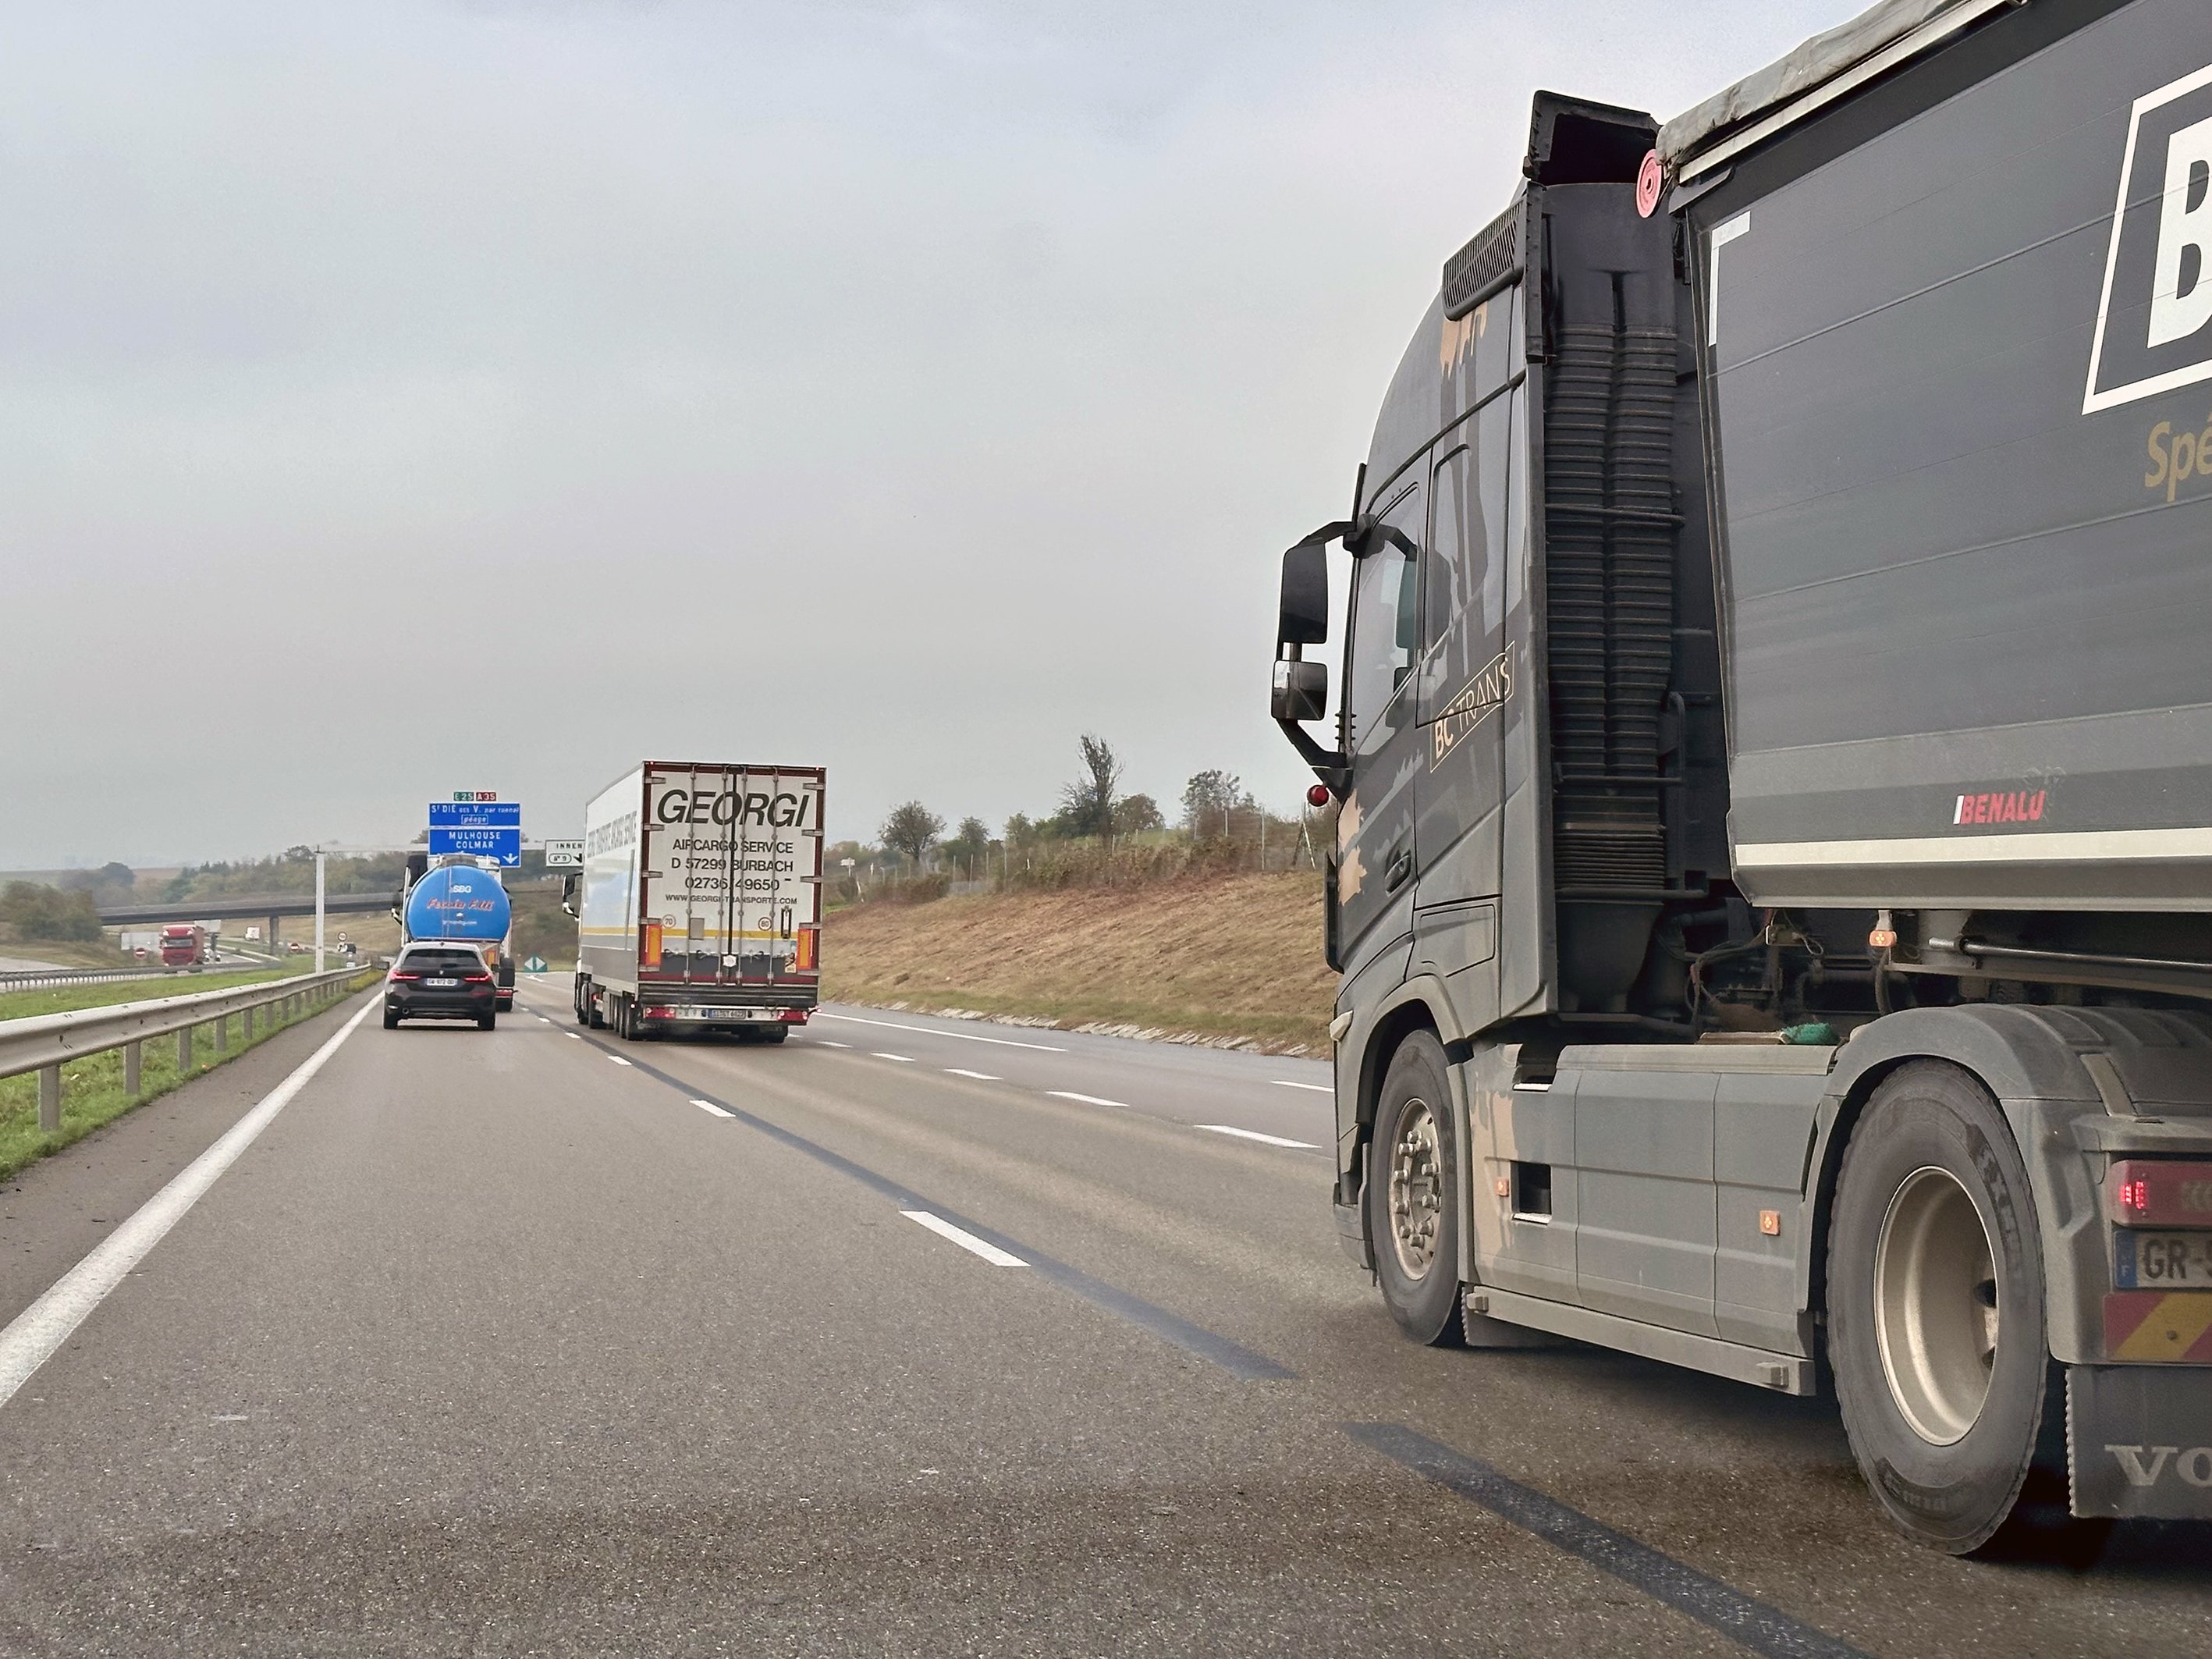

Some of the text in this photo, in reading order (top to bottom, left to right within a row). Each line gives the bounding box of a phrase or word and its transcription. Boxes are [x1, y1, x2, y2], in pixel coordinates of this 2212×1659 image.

[1435, 657, 1511, 760] BC TRANS
[657, 789, 810, 827] GEORGI
[1960, 790, 2047, 825] BENALU
[449, 831, 501, 840] MULHOUSE
[456, 840, 494, 849] COLMAR
[673, 839, 794, 854] AIRCARGO SERVCE
[672, 858, 794, 872] D 57299 BURBACH
[685, 877, 780, 890] 0273649650
[2104, 1444, 2212, 1487] VO
